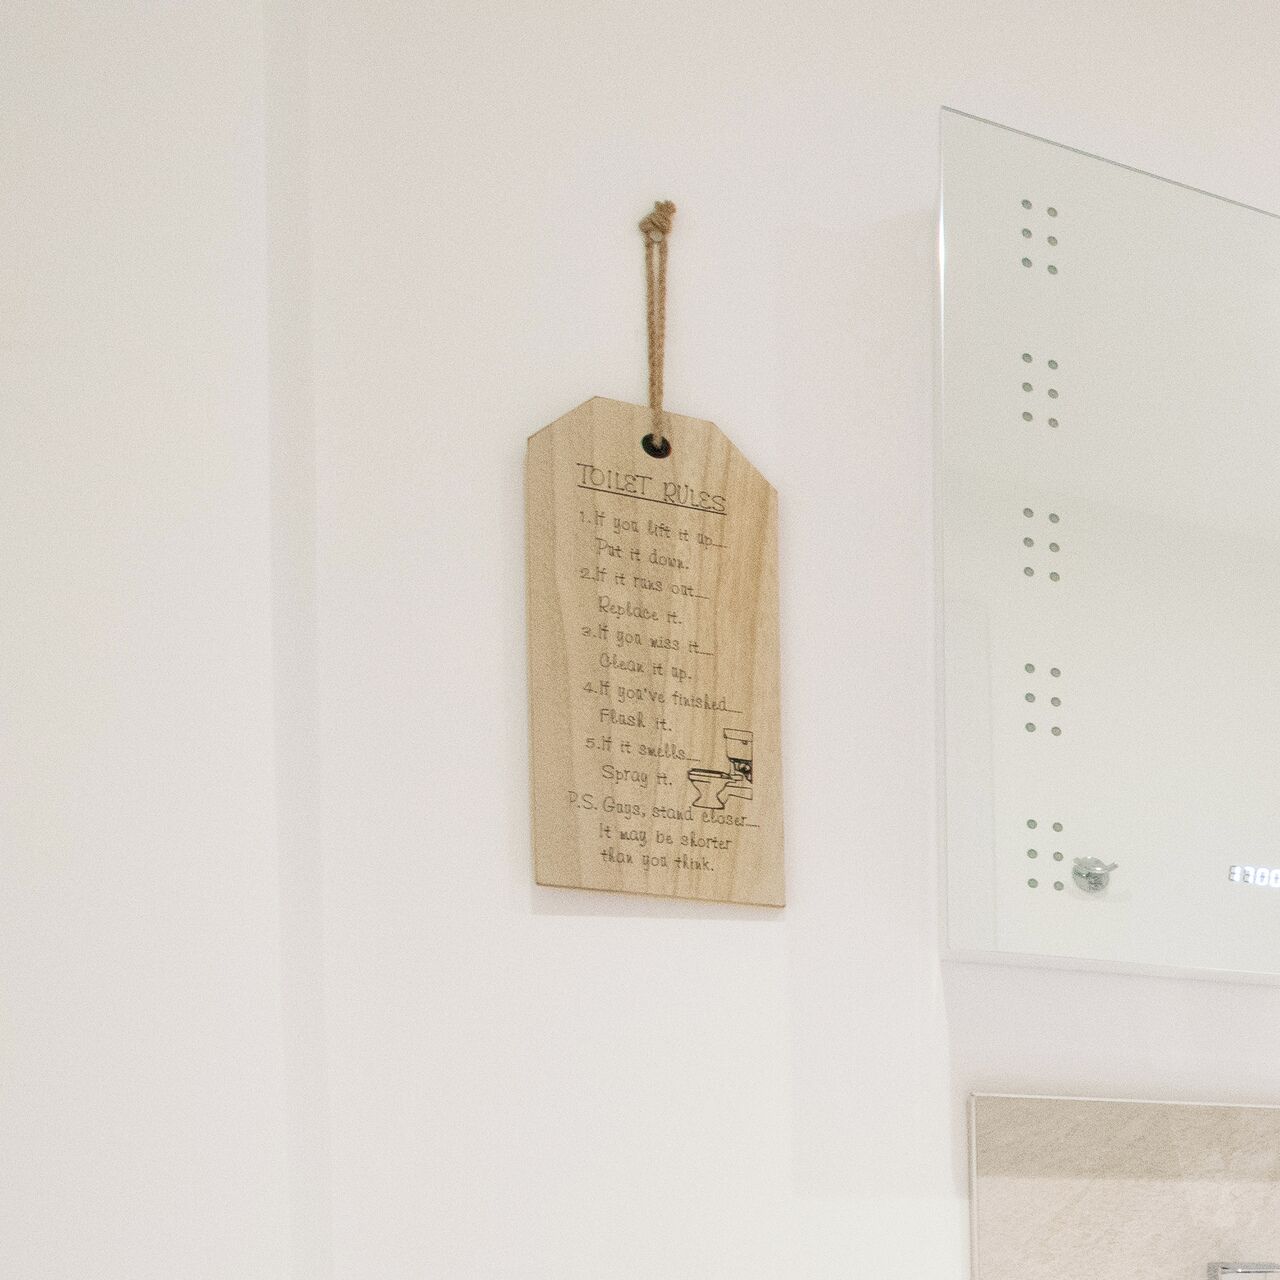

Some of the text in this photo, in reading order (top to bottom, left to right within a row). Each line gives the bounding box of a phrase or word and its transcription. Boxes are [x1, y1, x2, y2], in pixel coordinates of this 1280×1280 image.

[577, 463, 726, 512] TOILET RULES
[614, 518, 639, 534] you
[648, 520, 670, 538] lift
[679, 529, 688, 541] it
[596, 537, 689, 569] Put it down.
[615, 573, 625, 585] it
[633, 577, 662, 592] runs
[599, 596, 682, 624] Replace it.
[617, 630, 641, 647] you
[650, 638, 679, 650] miss
[600, 652, 692, 682] Clean it up.
[619, 686, 664, 703] you've
[600, 708, 672, 731] Flush it.
[621, 741, 631, 753] it
[602, 765, 672, 788] Spray it.
[568, 790, 597, 810] P.S.
[603, 796, 646, 819] Guys,
[652, 806, 693, 821] stand
[599, 823, 732, 850] It may be shorter
[601, 847, 714, 871] than you think.
